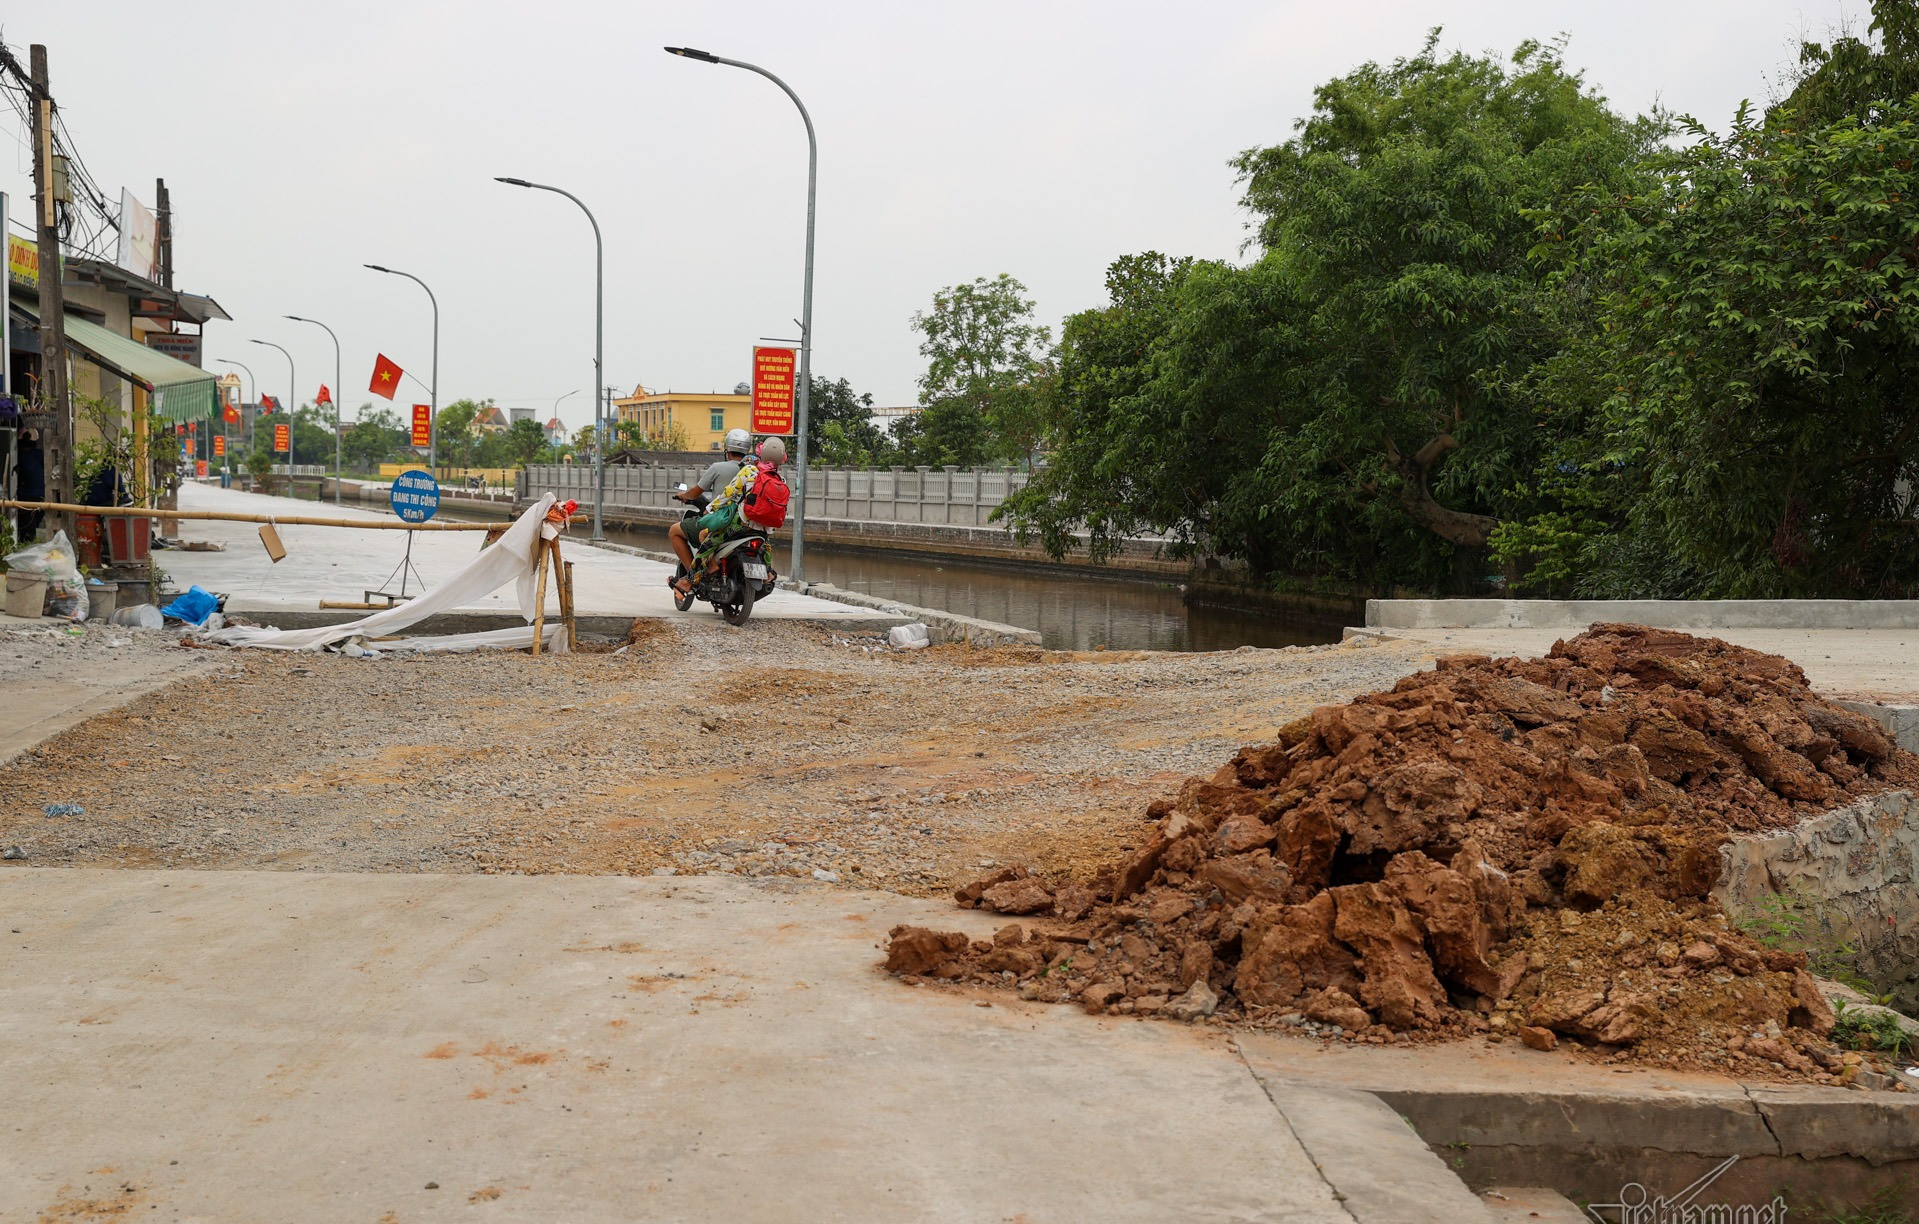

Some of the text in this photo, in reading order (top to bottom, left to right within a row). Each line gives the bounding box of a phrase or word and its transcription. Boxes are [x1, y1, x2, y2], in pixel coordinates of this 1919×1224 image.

[399, 475, 435, 491] CÔNG TRƯỜNG
[393, 492, 437, 507] ĐANG THI CÔNG
